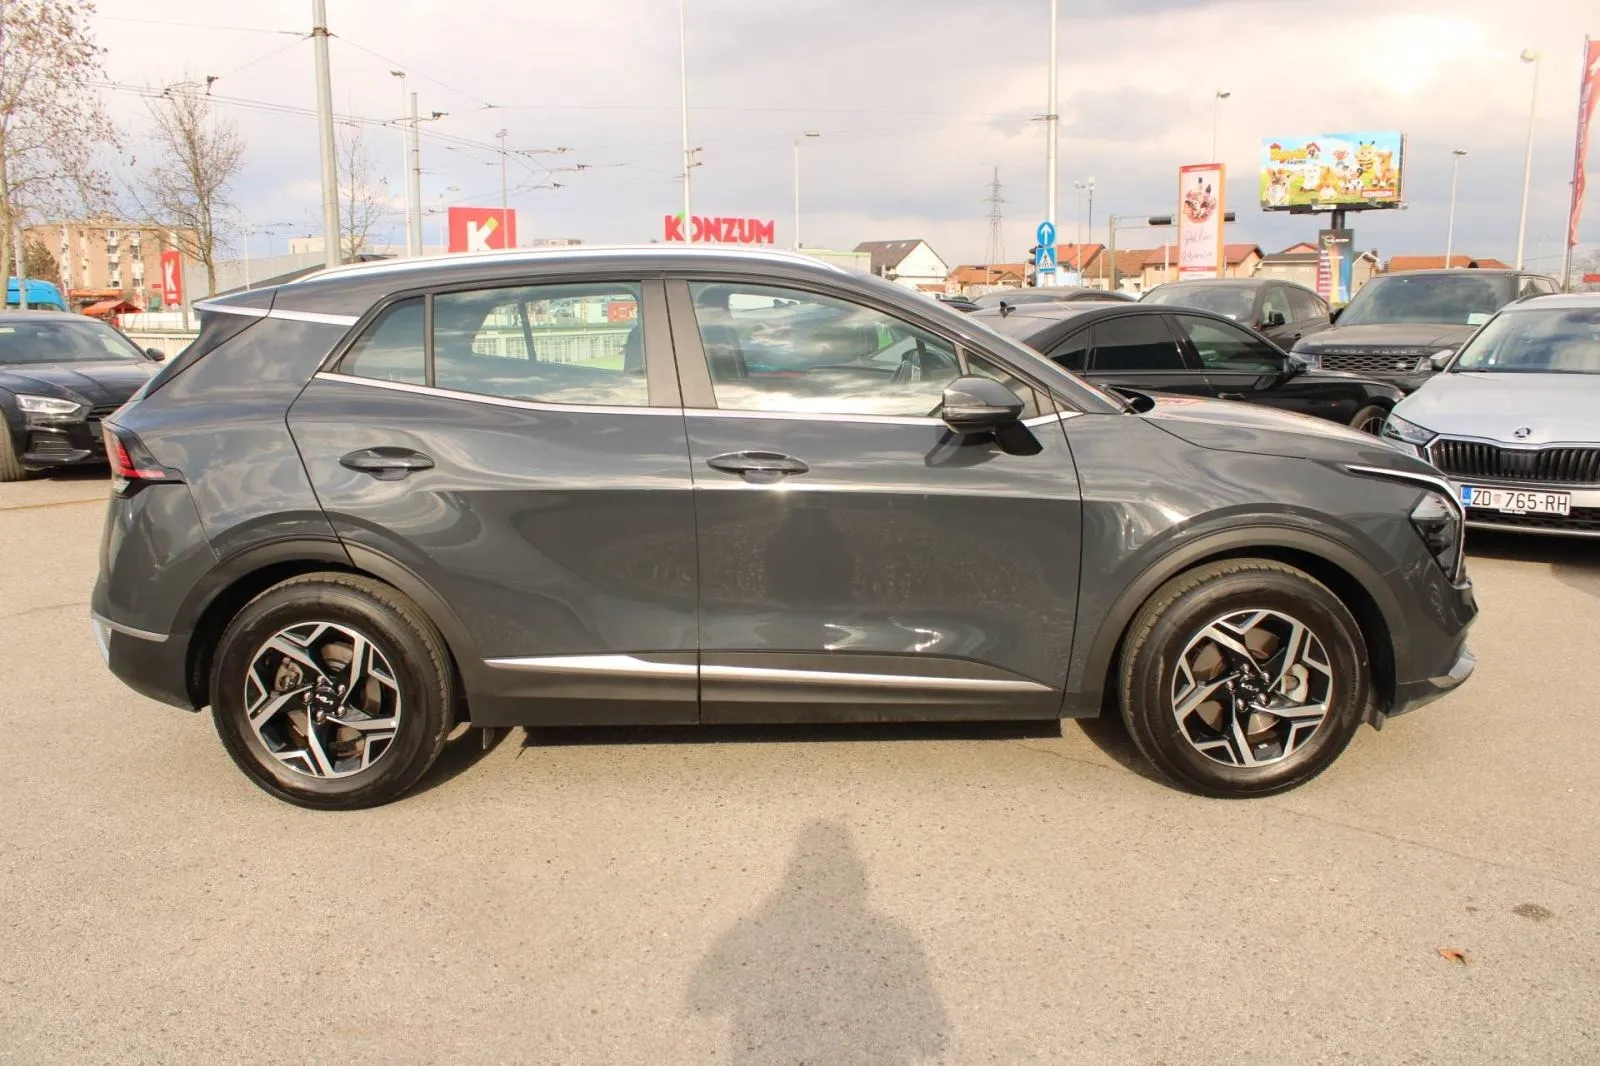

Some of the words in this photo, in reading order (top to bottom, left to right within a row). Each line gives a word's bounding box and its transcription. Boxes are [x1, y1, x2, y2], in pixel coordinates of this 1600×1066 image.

[467, 216, 499, 252] K
[1472, 490, 1492, 506] ZD
[1505, 492, 1569, 512] 765-RH
